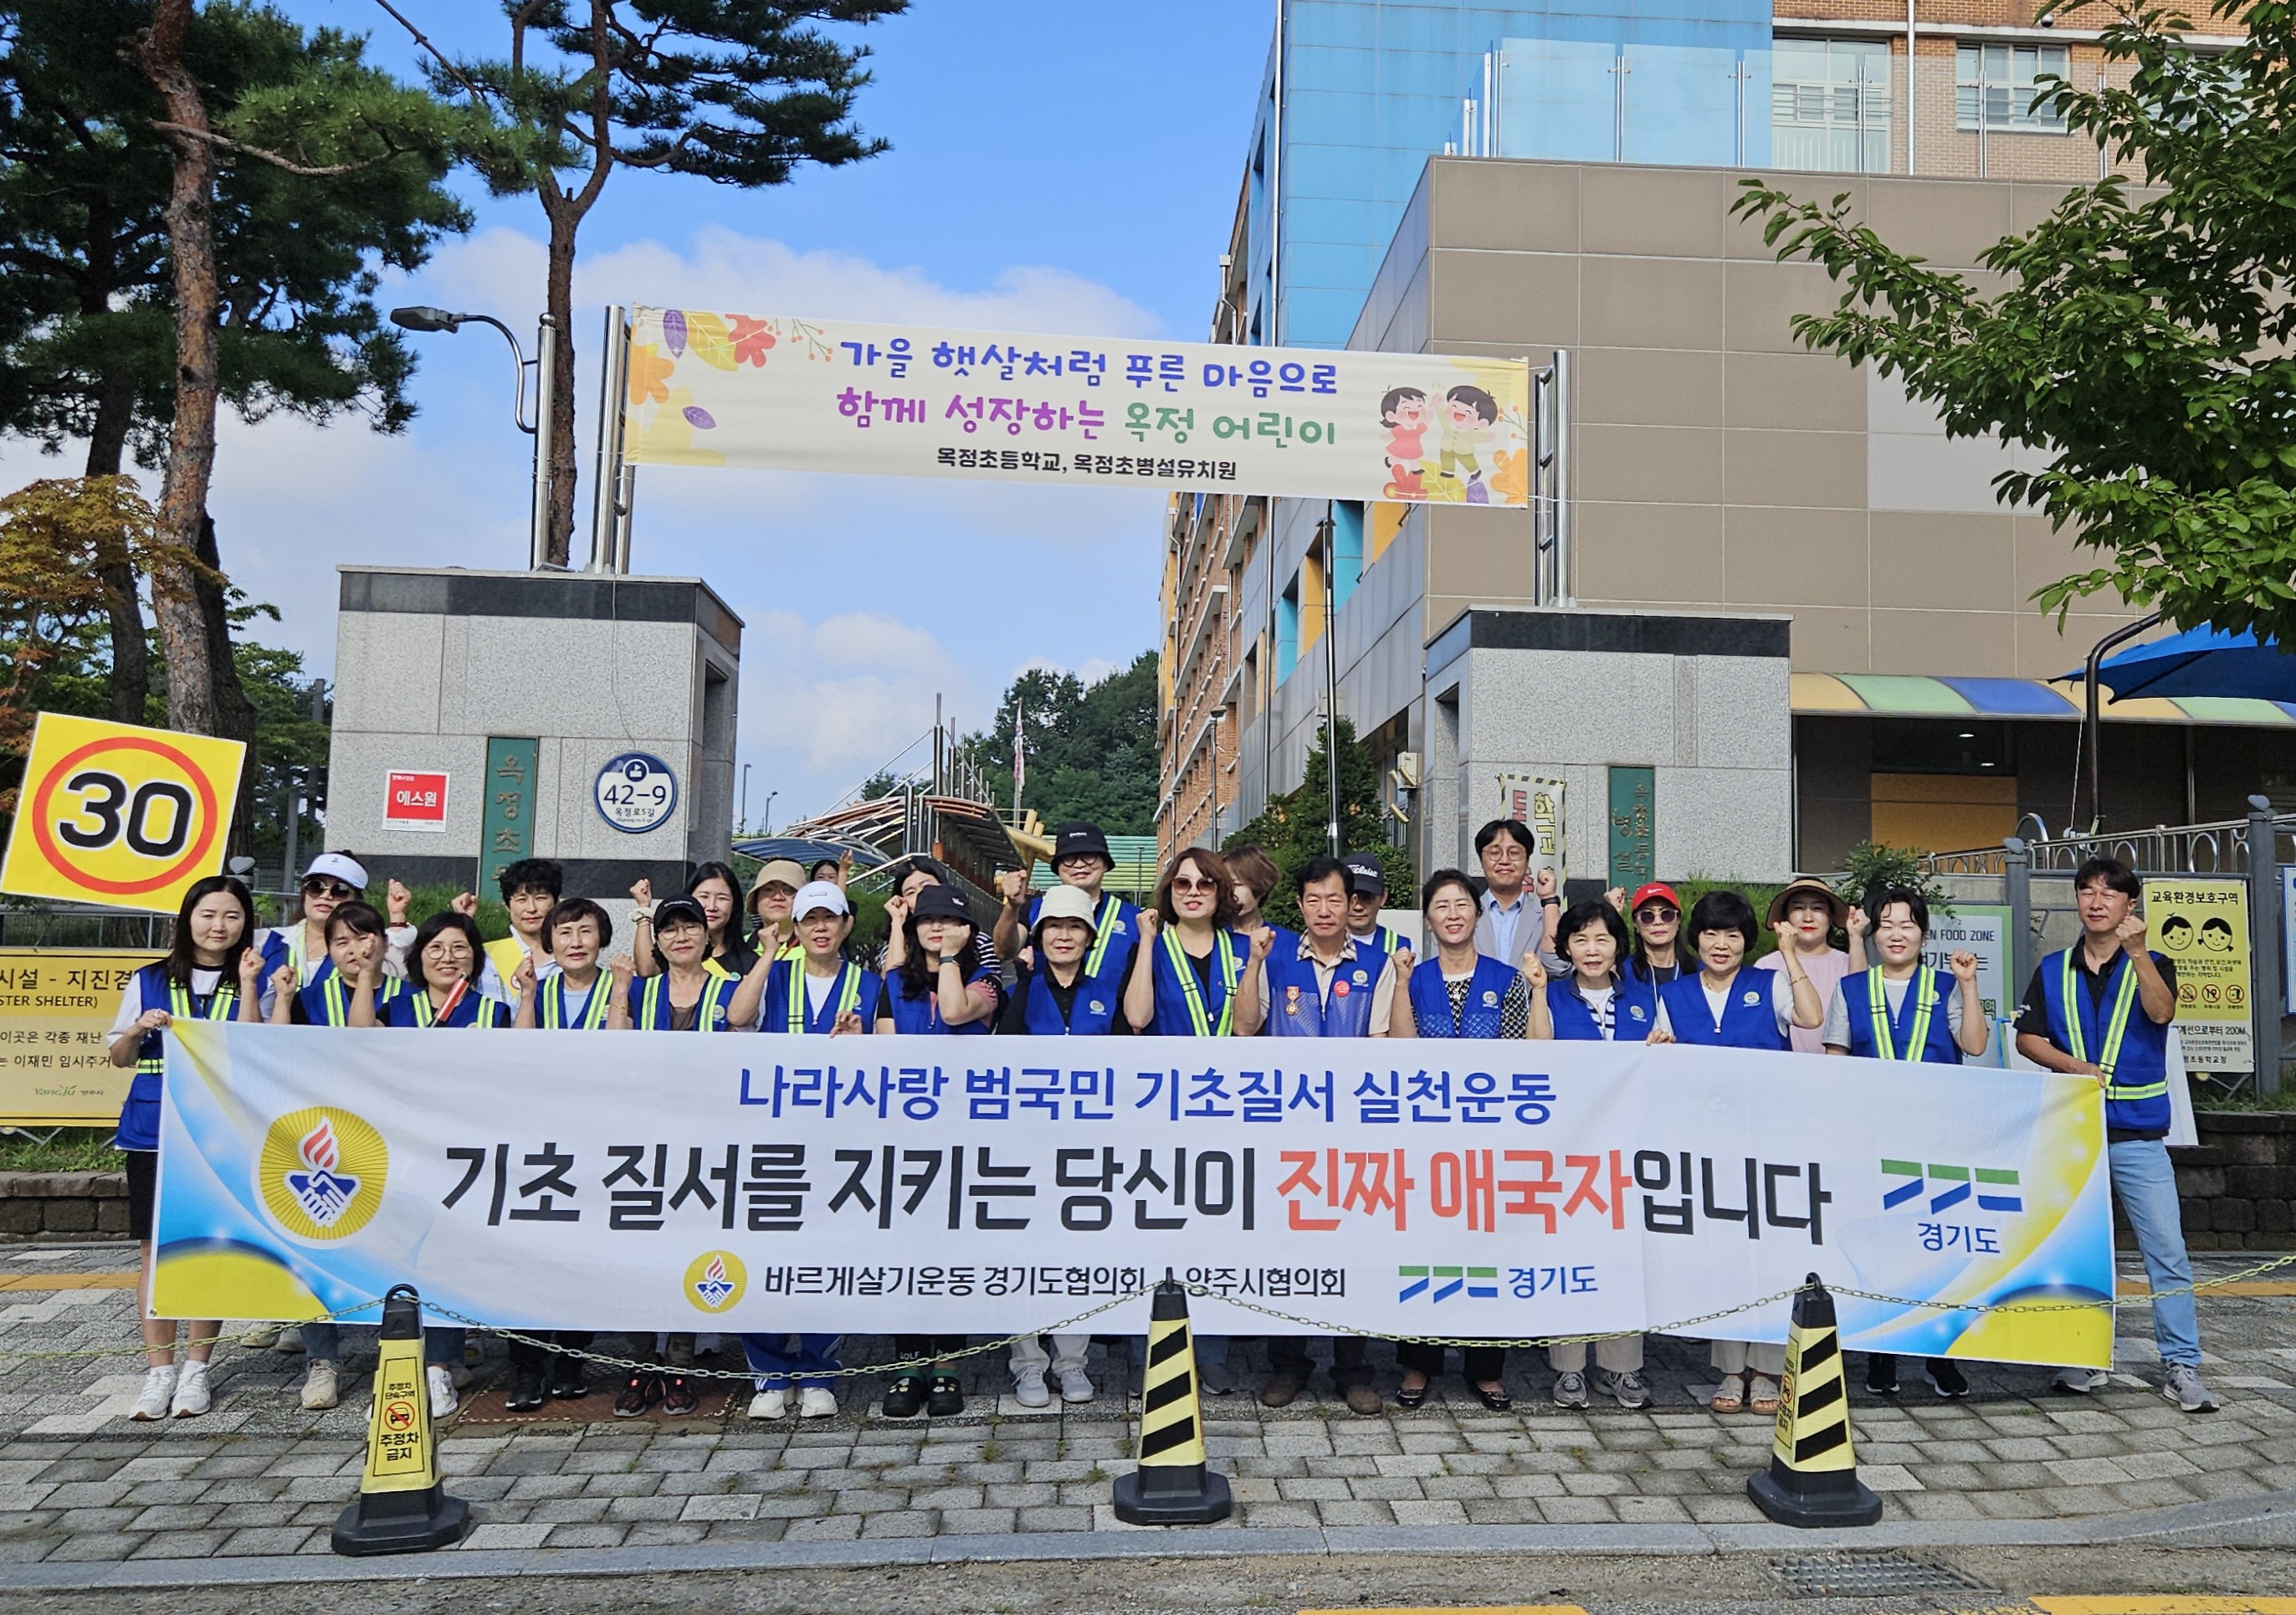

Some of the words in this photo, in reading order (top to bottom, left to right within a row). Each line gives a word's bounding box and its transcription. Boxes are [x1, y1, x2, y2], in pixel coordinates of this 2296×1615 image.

[840, 338, 913, 378] 가을
[931, 341, 1107, 387] 햇살처럼
[1125, 354, 1186, 392] 푸른
[1203, 360, 1338, 397] 마음으로
[837, 387, 925, 428] 함께
[946, 395, 1105, 440] 성장하는
[1125, 402, 1195, 444] 옥정
[1212, 412, 1335, 449] 어린이
[938, 448, 1068, 474] 옥정초등학교,
[1074, 454, 1237, 480] 옥정초병설유치원
[397, 790, 437, 807] 에스원
[603, 784, 666, 806] 42-9
[59, 772, 193, 857] 30
[615, 807, 654, 818] 옥정로5길
[2151, 891, 2238, 905] 교육환경보호구역
[1940, 930, 1966, 941] FOOD
[1971, 931, 1995, 941] ZONE
[35, 996, 98, 1009] SHELTER)
[1, 1031, 39, 1043] 이곳은
[45, 1031, 71, 1044] 각종
[76, 1031, 102, 1044] 재난
[14, 1054, 53, 1068] 이재민
[740, 1064, 949, 1120] 나라사랑
[966, 1066, 1115, 1120] 범국민
[1135, 1067, 1335, 1123] 기초질서
[1353, 1069, 1556, 1125] 실천운동
[442, 1142, 581, 1227] 기초
[602, 1143, 812, 1231] 질서를
[828, 1145, 1037, 1230] 지키는
[1055, 1146, 1256, 1231] 당신이
[1277, 1148, 1415, 1232] 진짜
[1430, 1149, 1832, 1246] 애국자입니다
[1917, 1222, 2001, 1254] 경기도
[765, 1266, 975, 1296] 바르게살기운동
[982, 1266, 1145, 1298] 경기도협의회
[1185, 1267, 1346, 1298] 양주시협의회
[1508, 1265, 1599, 1300] 경기도
[381, 1432, 419, 1446] 주정차
[387, 1447, 412, 1462] 금지
